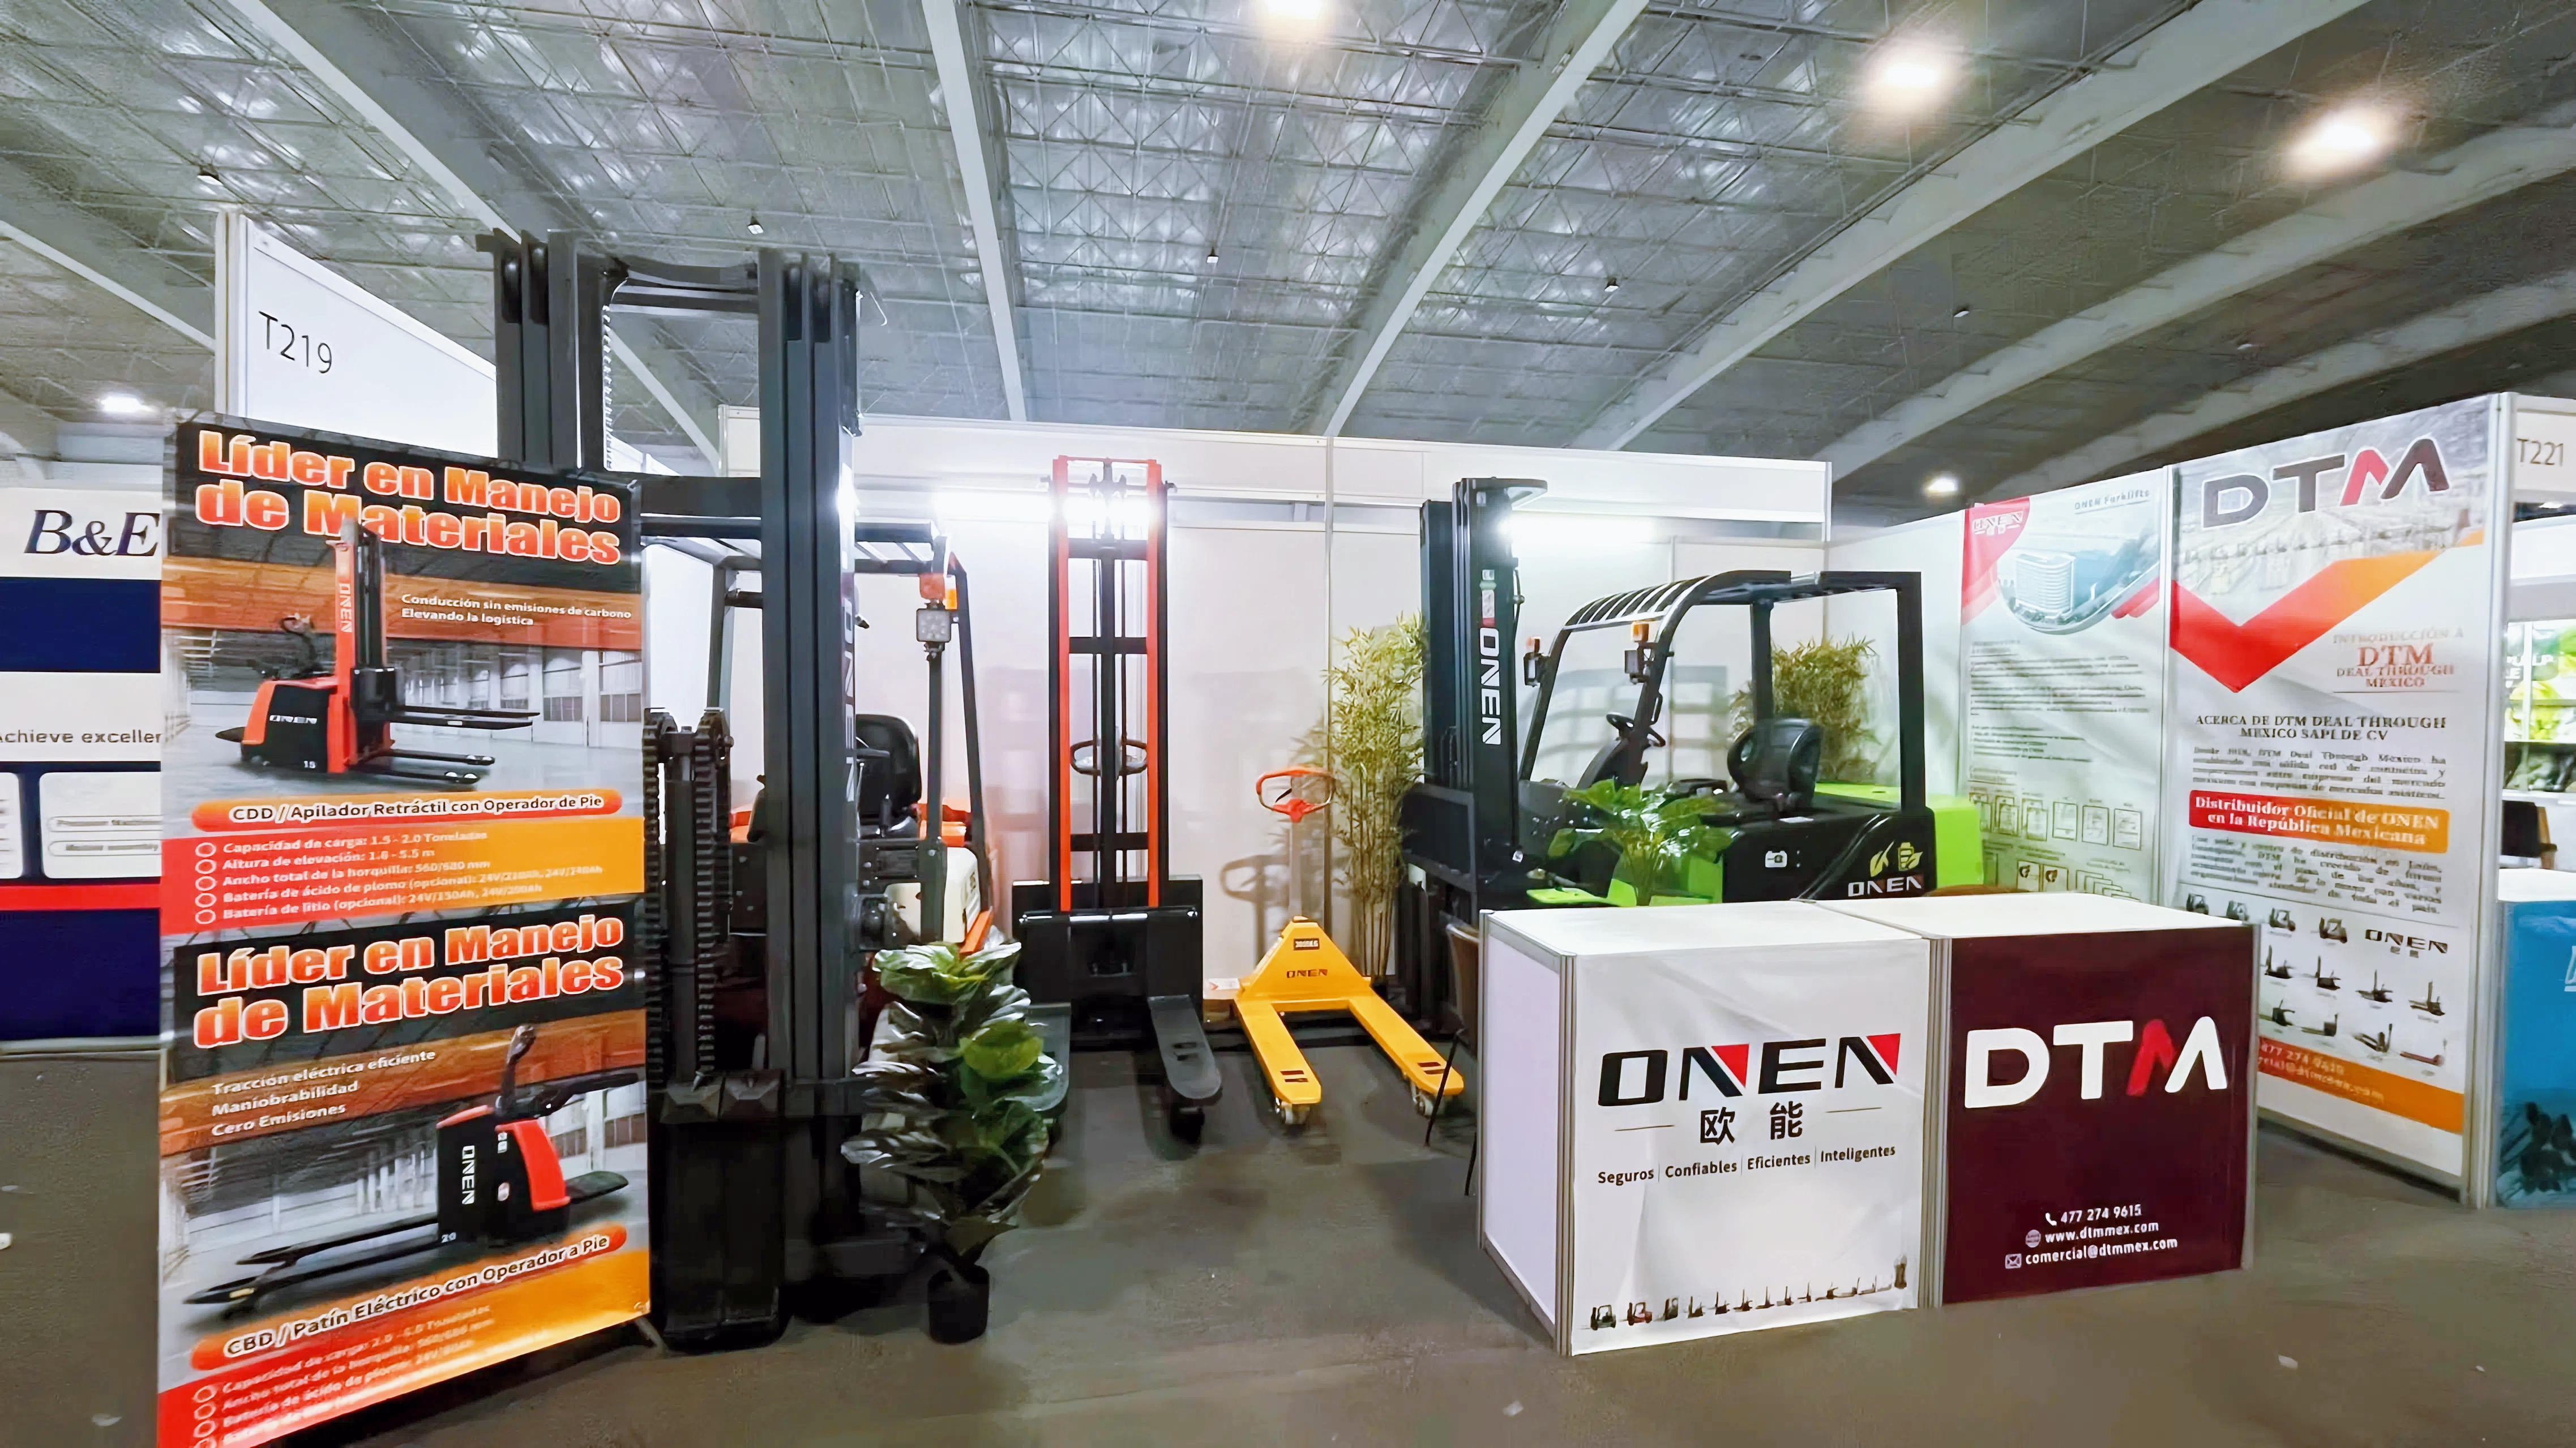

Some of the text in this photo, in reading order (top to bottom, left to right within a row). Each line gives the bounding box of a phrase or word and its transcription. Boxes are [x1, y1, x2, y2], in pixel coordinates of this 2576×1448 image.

[258, 311, 332, 374] T219
[2517, 438, 2564, 466] T221
[199, 430, 621, 523] Líder en Manejo
[2203, 438, 2449, 528] DTM
[23, 509, 160, 556] B&E
[195, 479, 621, 565] de Materiales
[339, 582, 353, 633] ONEN
[401, 594, 632, 619] Conducción sin emisiones de carbono
[401, 609, 534, 626] Elevando la logística
[2357, 642, 2433, 667] DTM
[1480, 627, 1501, 745] ONEN
[2366, 676, 2425, 687] MEXICO
[2196, 715, 2446, 728] ACERCA DE DTM DEAL THROUGH
[2240, 728, 2297, 738] MEXICO
[2341, 730, 2361, 740] DE
[2367, 730, 2388, 740] CV
[233, 807, 273, 820] CDD
[291, 804, 369, 820] Apilador
[374, 800, 447, 815] Retráctil
[452, 803, 478, 812] con
[484, 798, 555, 813] Operador
[559, 797, 576, 808] de
[580, 795, 602, 807] Pie
[2196, 796, 2439, 829] Distribuidor Oficial de ONEN
[223, 839, 301, 854] Capacidad
[304, 839, 322, 849] de
[324, 837, 367, 849] carga:
[401, 834, 421, 843] 2.0
[423, 832, 487, 842] Toneladas
[2208, 813, 2427, 845] en la República Mexicana
[222, 859, 269, 869] Altura
[273, 856, 291, 866] de
[294, 851, 365, 865] elevación:
[222, 875, 269, 886] Ancho
[273, 871, 308, 882] total
[311, 870, 328, 880] de
[332, 868, 344, 879] la
[223, 888, 278, 903] Batería
[281, 888, 299, 898] de
[302, 885, 340, 896] ácido
[344, 883, 361, 893] de
[363, 880, 406, 894] plomo
[1848, 876, 1923, 897] ONEN
[223, 905, 277, 919] Batería
[281, 904, 299, 914] de
[302, 901, 331, 914] litio
[198, 914, 623, 996] Líder en Manejo
[2365, 929, 2447, 954] ONEN
[1286, 969, 1328, 979] ONEN
[194, 956, 623, 1049] de Materiales
[212, 1050, 436, 1095] Tracción eléctrica eficiente
[1598, 1033, 1901, 1107] ONEN
[1965, 1016, 2227, 1108] DTM
[212, 1080, 358, 1116] Maniobrabilidad
[212, 1103, 346, 1137] Cero Emisiones
[1700, 1100, 1803, 1145] 欧能
[462, 1145, 476, 1205] ONEN
[1598, 1145, 1895, 1186] Seguros Confiables Eficientes Inteligentes
[2060, 1204, 2142, 1224] 477 274 9615
[2045, 1222, 2159, 1243] www.dtmmex.com
[2025, 1239, 2178, 1265] comercial@dtmmex.com
[228, 1332, 273, 1354] CBD
[294, 1310, 349, 1336] Patín
[355, 1286, 440, 1318] Eléctrico
[446, 1274, 477, 1293] con
[483, 1248, 566, 1280] Operador
[570, 1246, 578, 1257] a
[583, 1236, 608, 1253] Pie
